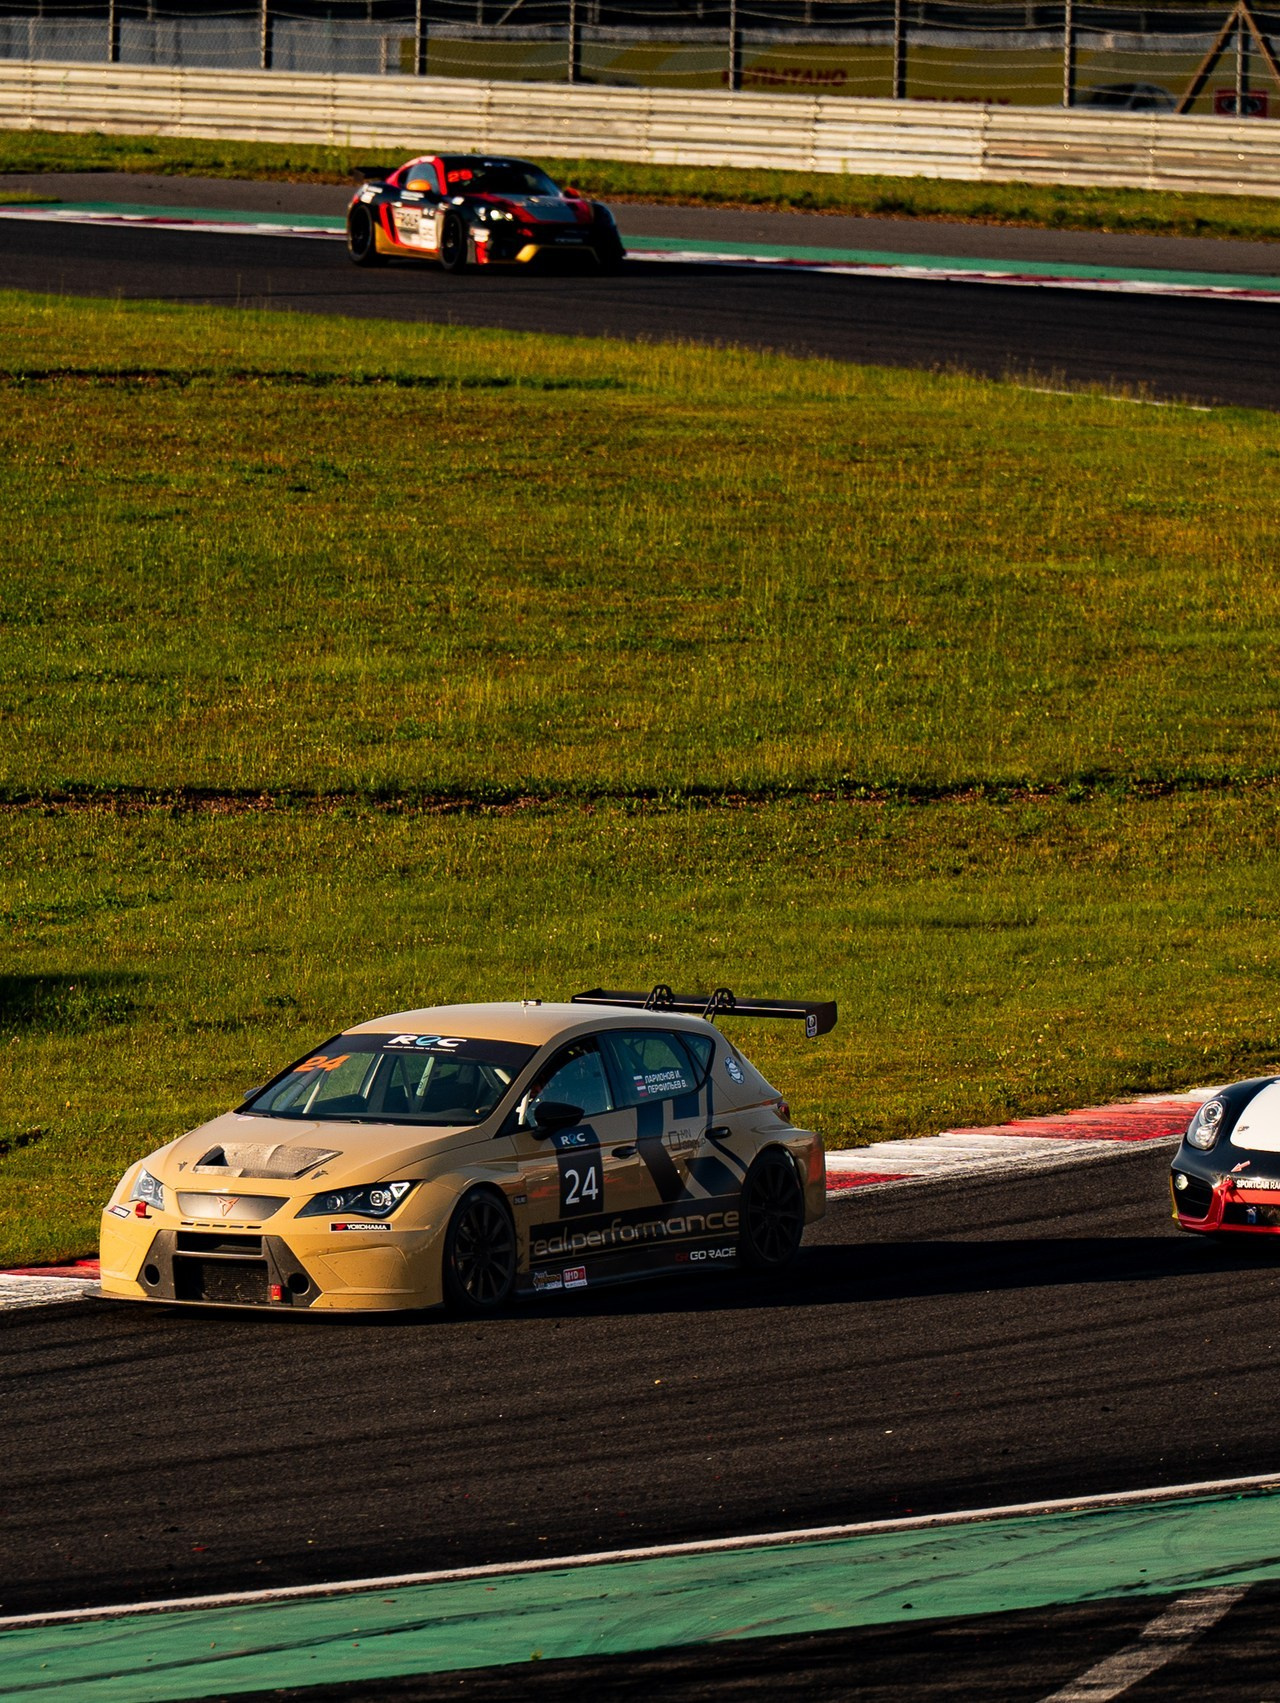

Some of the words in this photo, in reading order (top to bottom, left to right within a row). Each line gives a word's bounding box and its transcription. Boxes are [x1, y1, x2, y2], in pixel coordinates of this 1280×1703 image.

[722, 67, 849, 87] СПЫТАНО
[293, 1054, 350, 1073] 24
[564, 1166, 599, 1205] 24
[1236, 1179, 1270, 1190] SPORTCAR
[690, 1249, 707, 1261] GO
[708, 1246, 737, 1259] RACE
